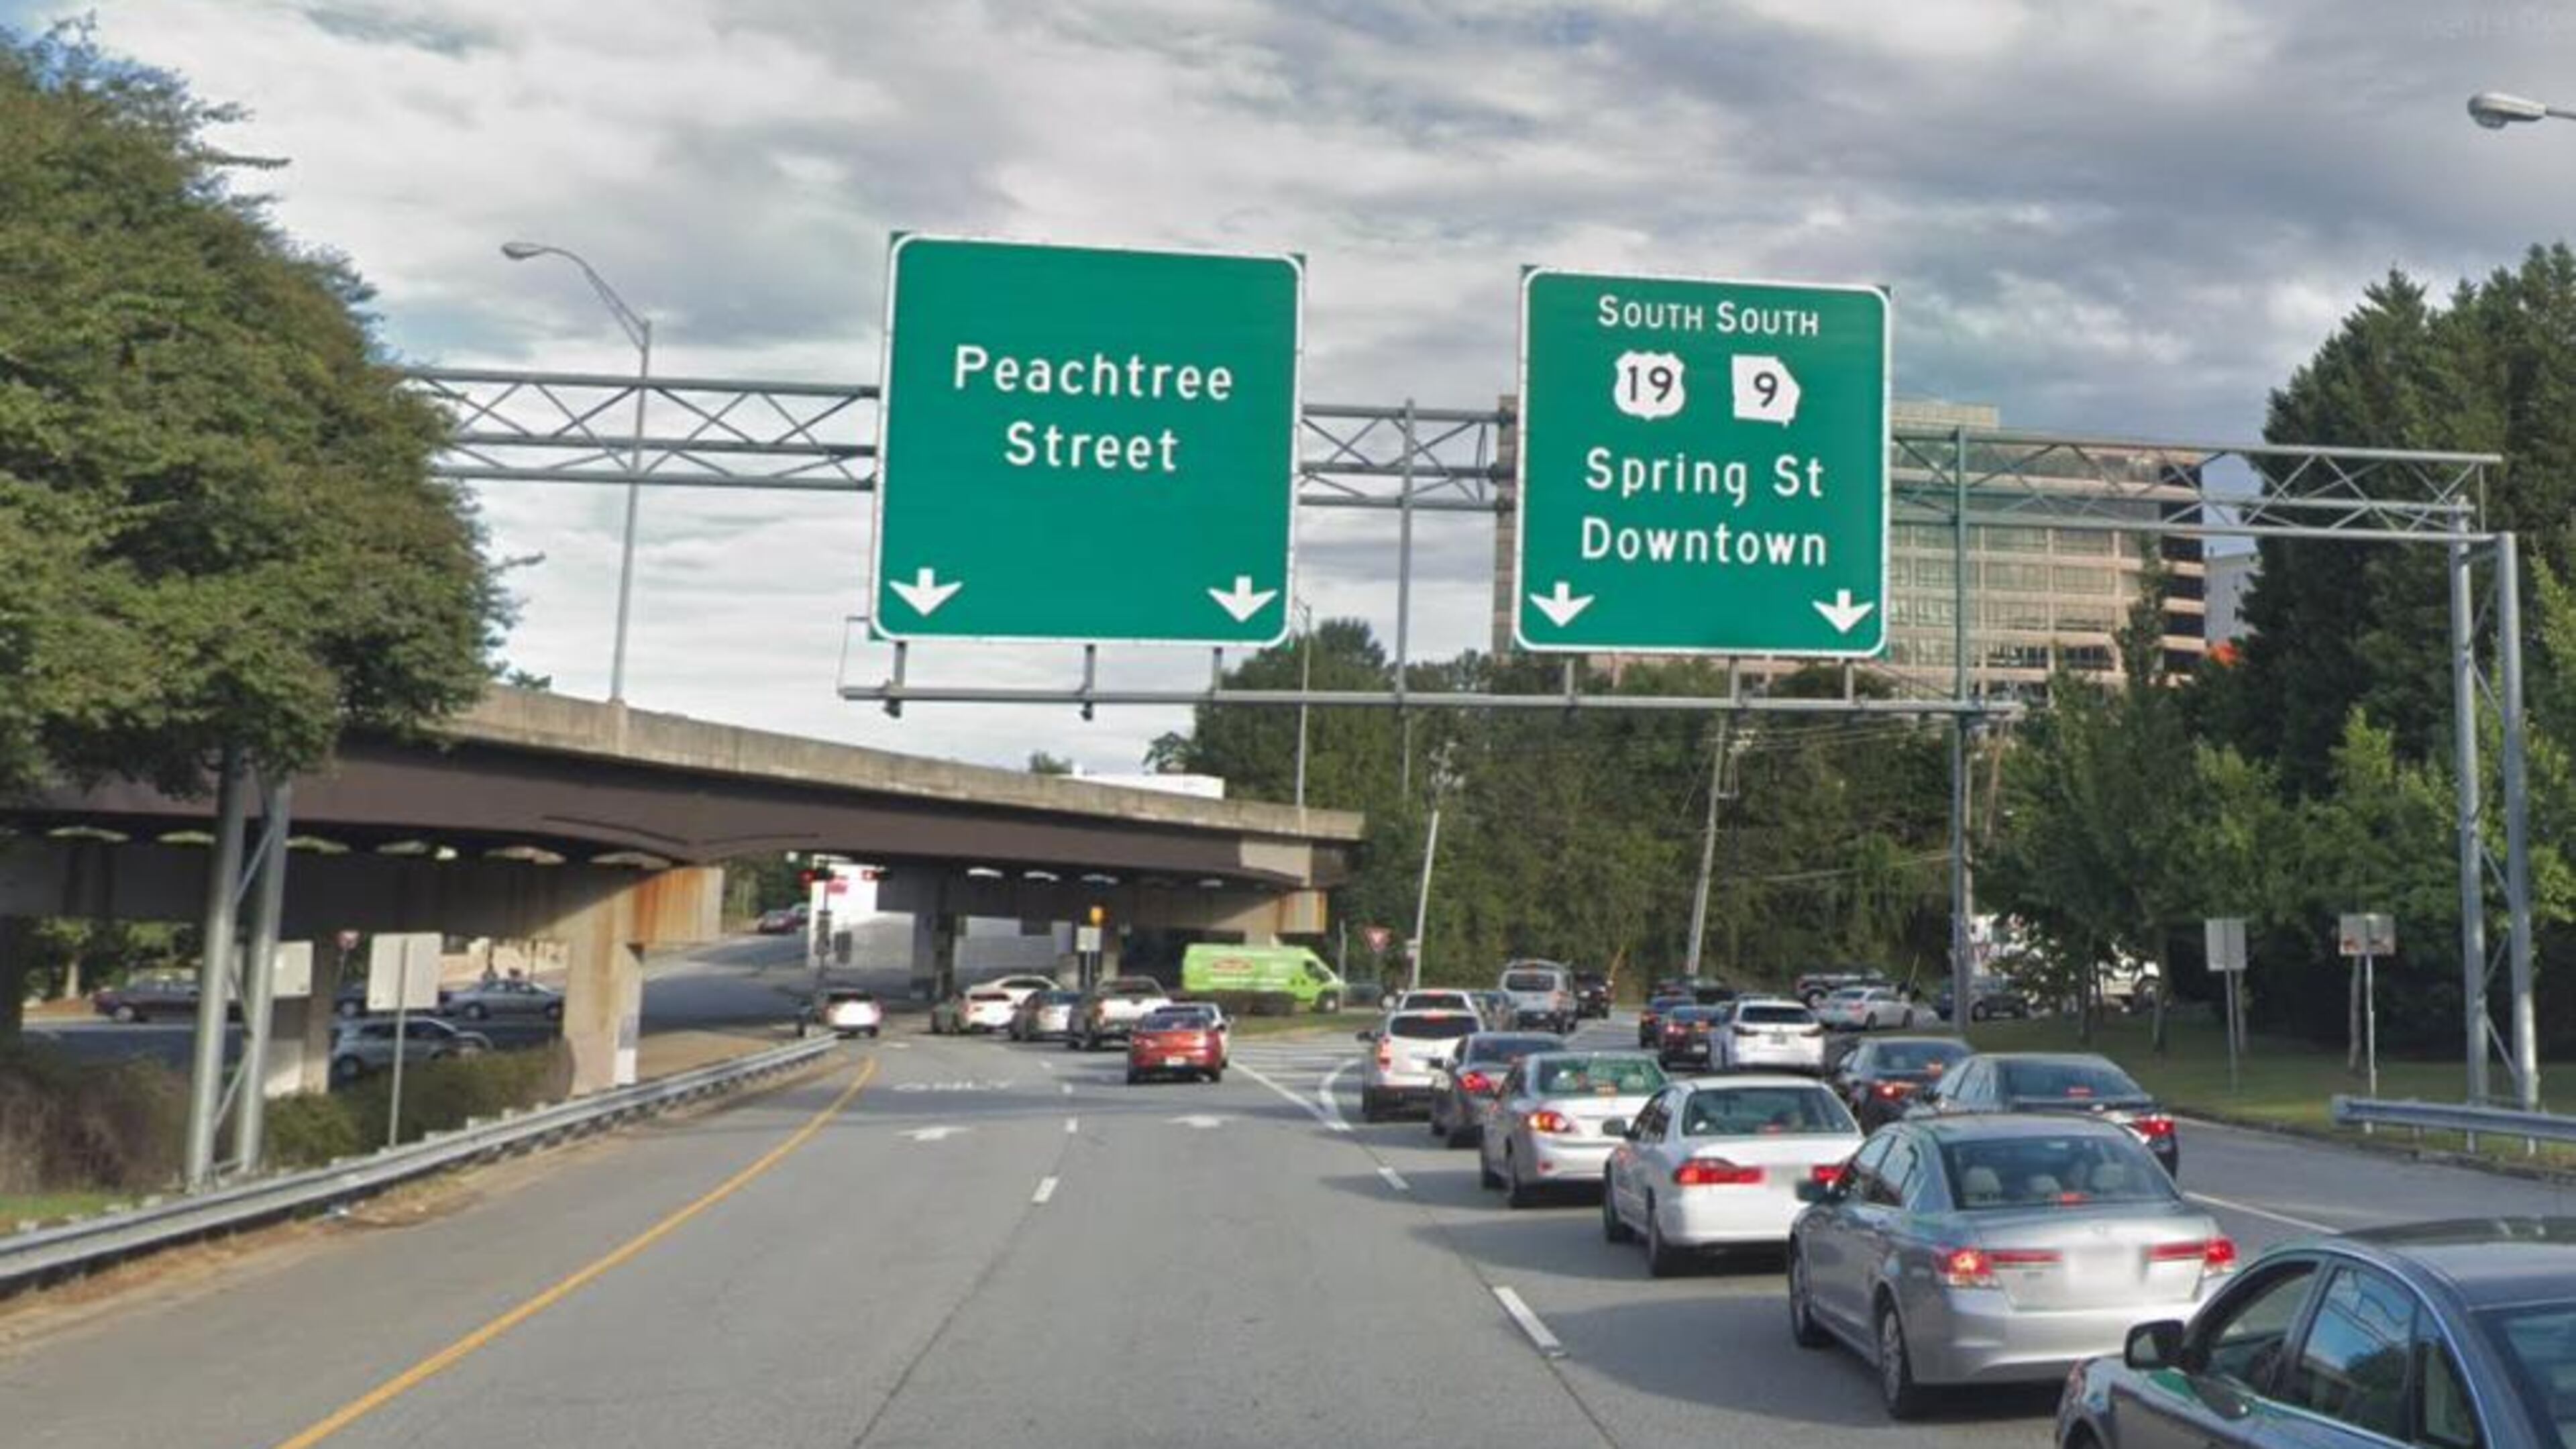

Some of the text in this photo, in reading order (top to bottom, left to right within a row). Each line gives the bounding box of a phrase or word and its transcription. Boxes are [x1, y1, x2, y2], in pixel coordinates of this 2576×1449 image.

[1598, 294, 1819, 337] SOUTH SOUTH
[954, 345, 1233, 401] Peachtree
[1627, 365, 1674, 404] 19
[1754, 370, 1780, 409] 9
[1006, 421, 1179, 472] Street
[1585, 446, 1824, 508] Spring St
[1582, 516, 1826, 567] Downtown
